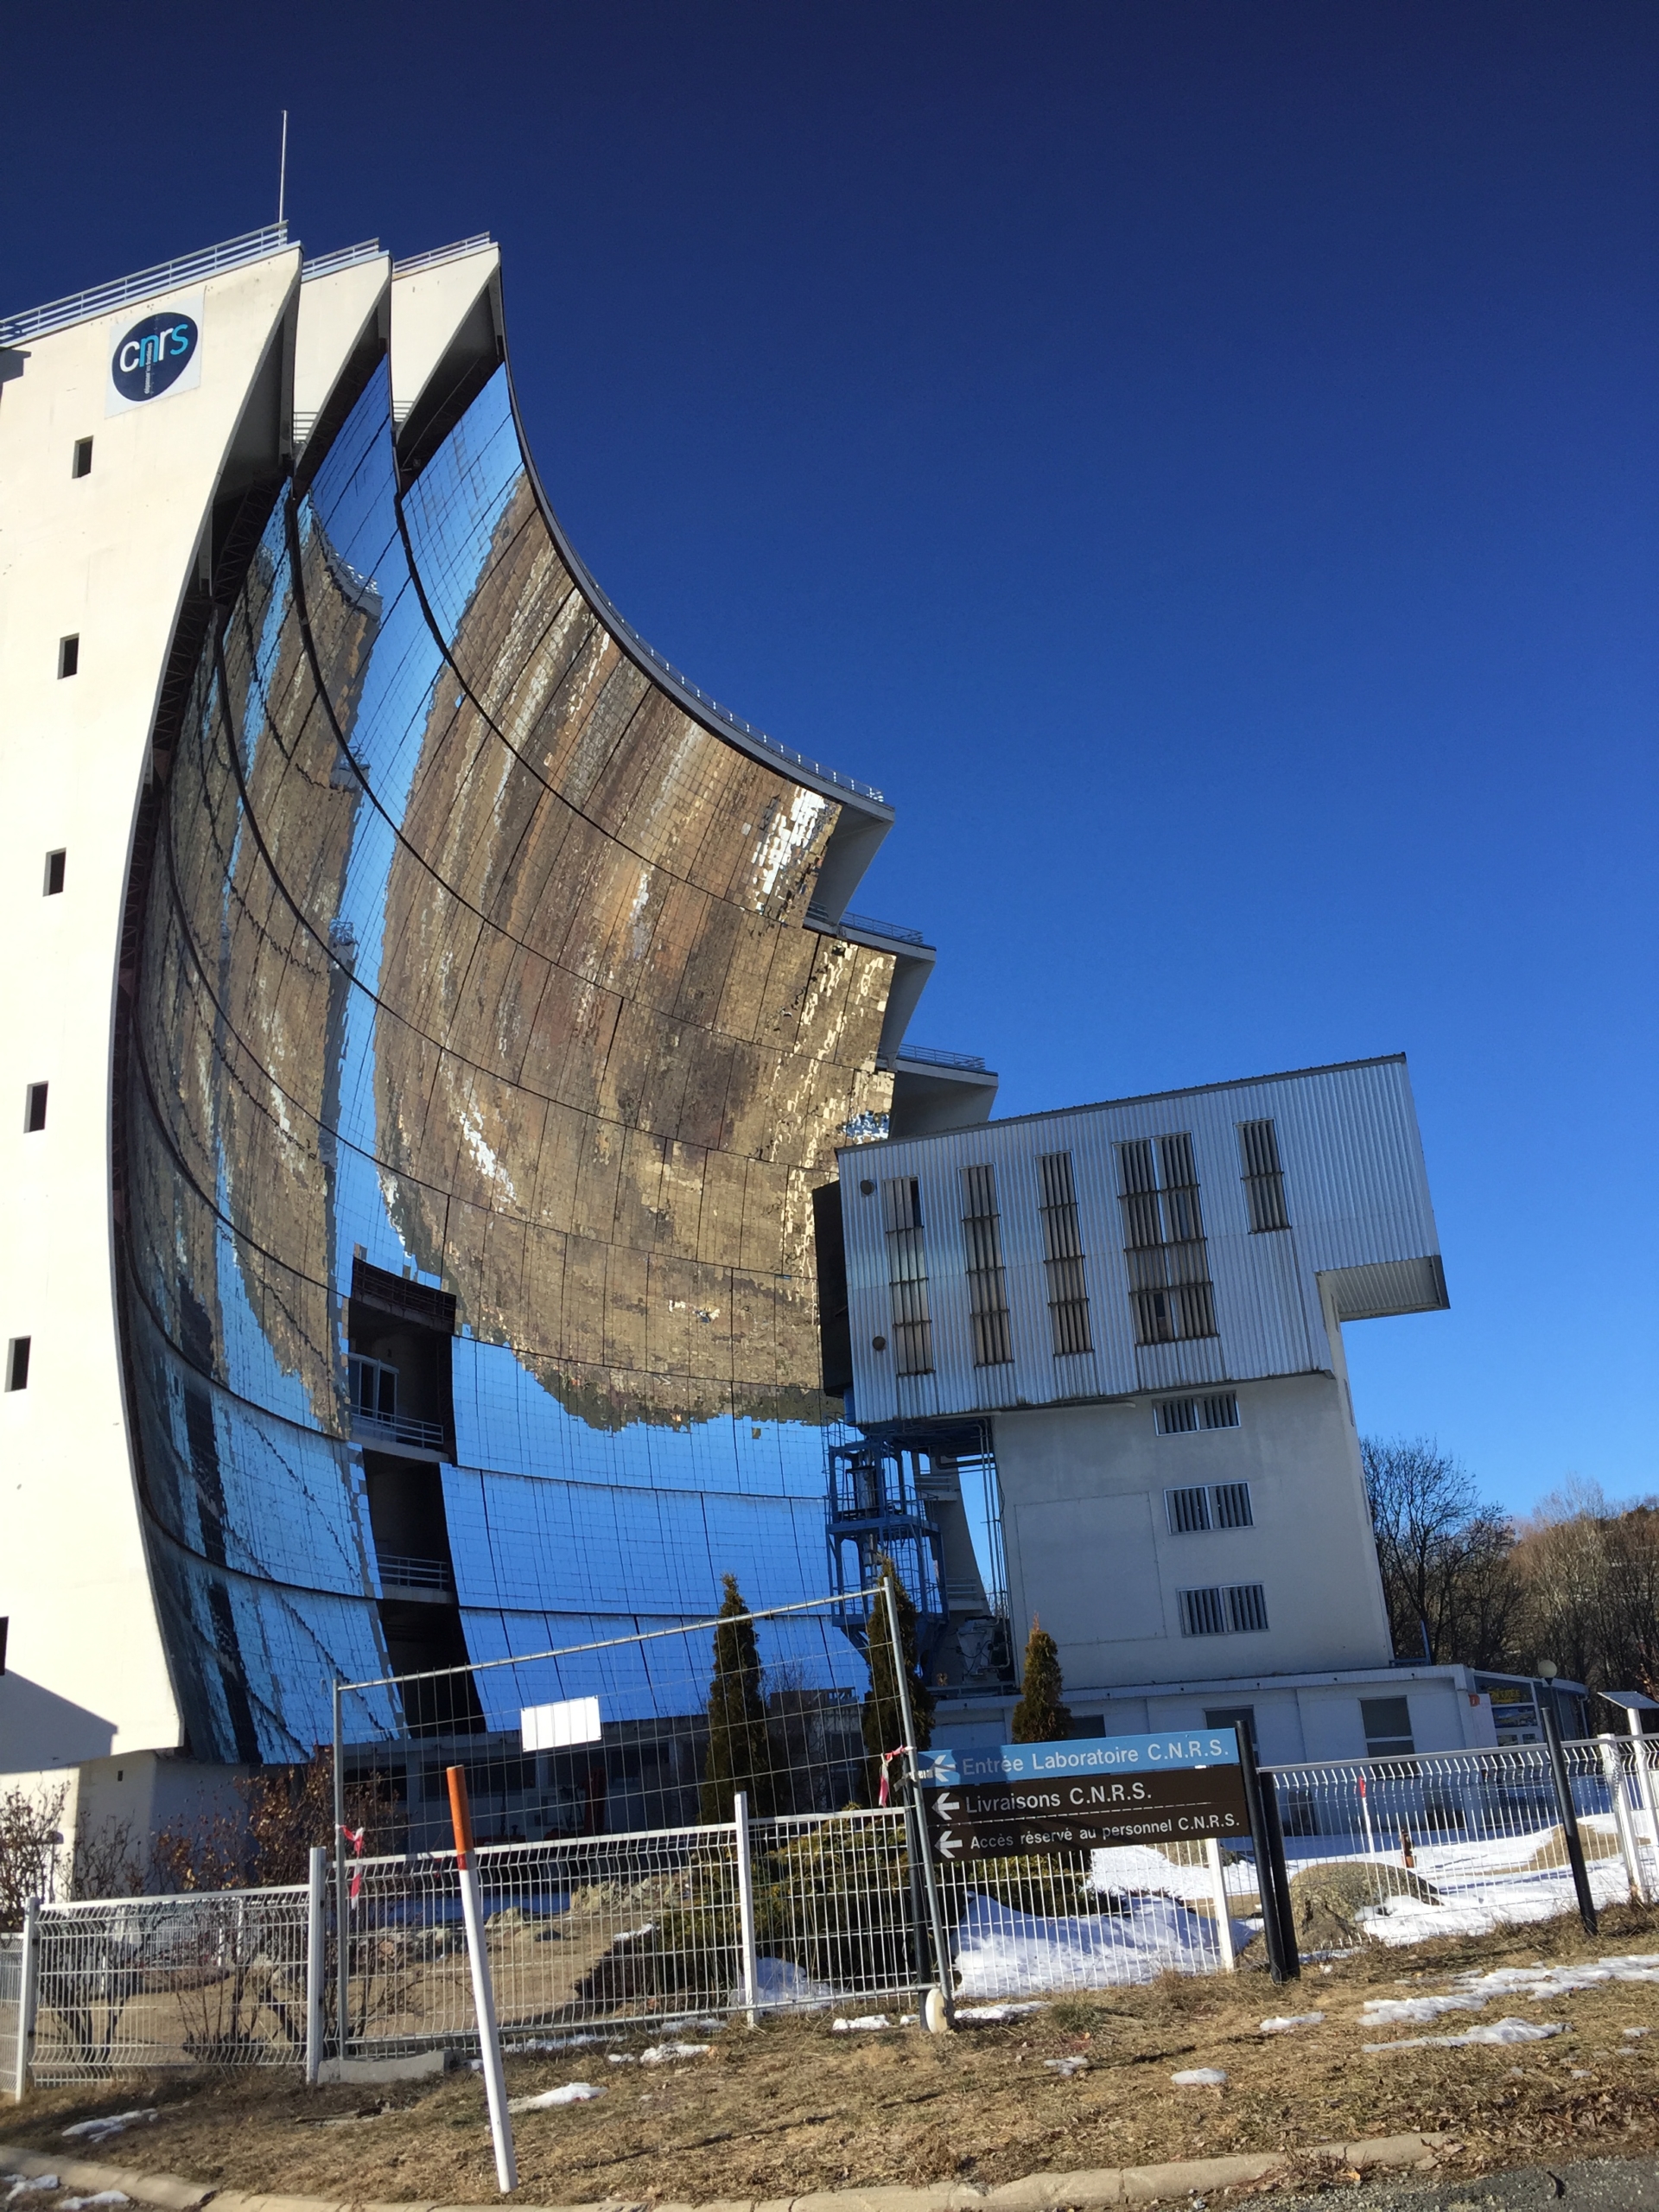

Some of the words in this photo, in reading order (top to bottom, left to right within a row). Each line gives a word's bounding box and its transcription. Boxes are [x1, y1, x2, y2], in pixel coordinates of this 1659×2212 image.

[119, 324, 189, 372] cnrs
[963, 1755, 1024, 1776] Entrée
[1032, 1746, 1139, 1770] Laboratoire
[1147, 1739, 1229, 1761] C.N.R.S.
[965, 1793, 1061, 1814] Livraisons
[1069, 1783, 1152, 1804] C.N.R.S.
[970, 1833, 1014, 1849] Accès
[1020, 1827, 1073, 1845] réservé
[1079, 1827, 1096, 1840] au
[1102, 1819, 1173, 1840] personnel
[1178, 1813, 1240, 1831] C.N.R.S.
